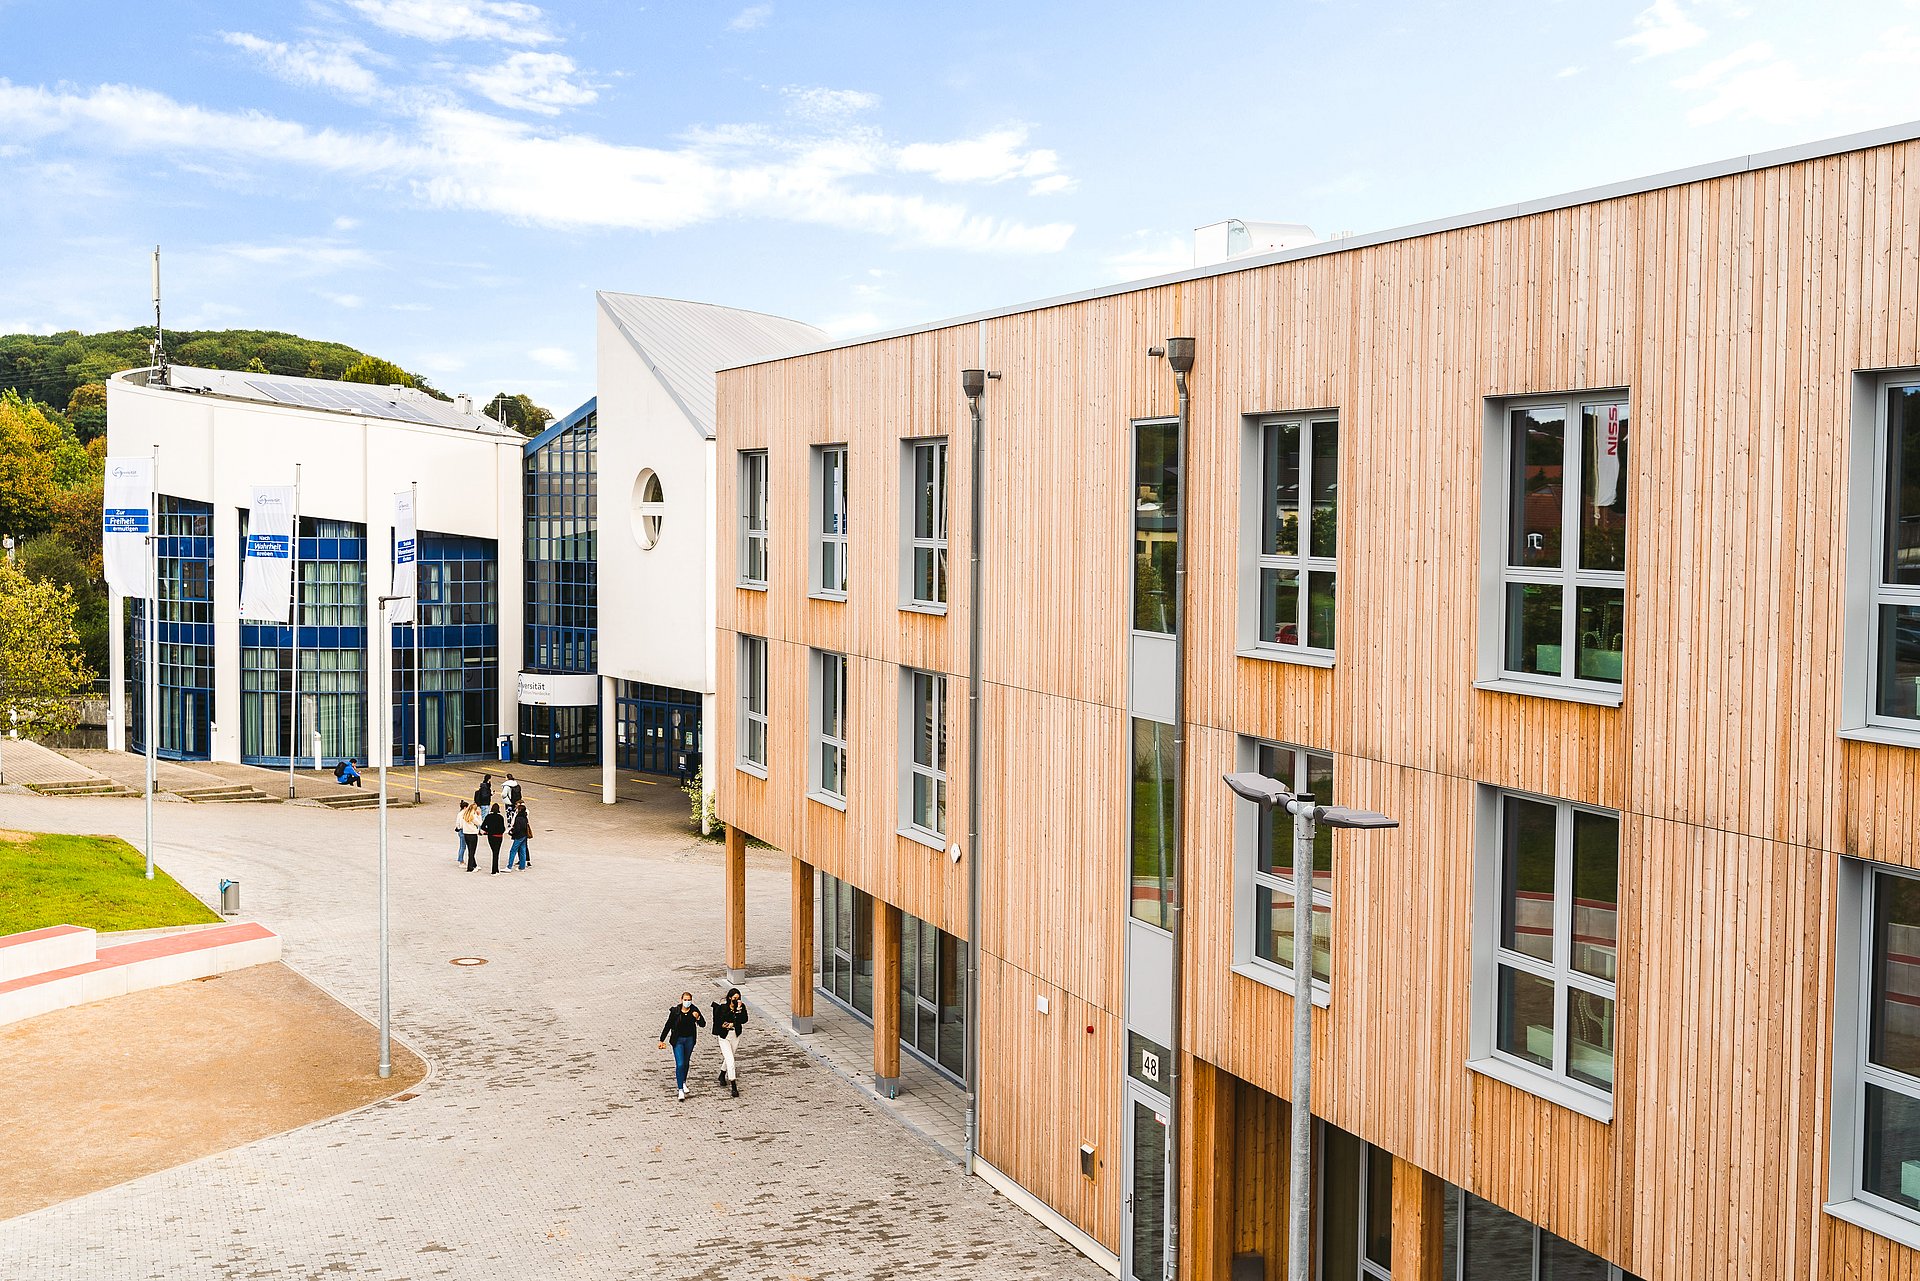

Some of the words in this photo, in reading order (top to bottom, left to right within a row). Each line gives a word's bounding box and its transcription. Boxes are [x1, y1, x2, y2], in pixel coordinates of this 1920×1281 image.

[1608, 405, 1618, 455] NISS
[110, 517, 135, 525] Freiheit
[1145, 1057, 1156, 1076] 48
